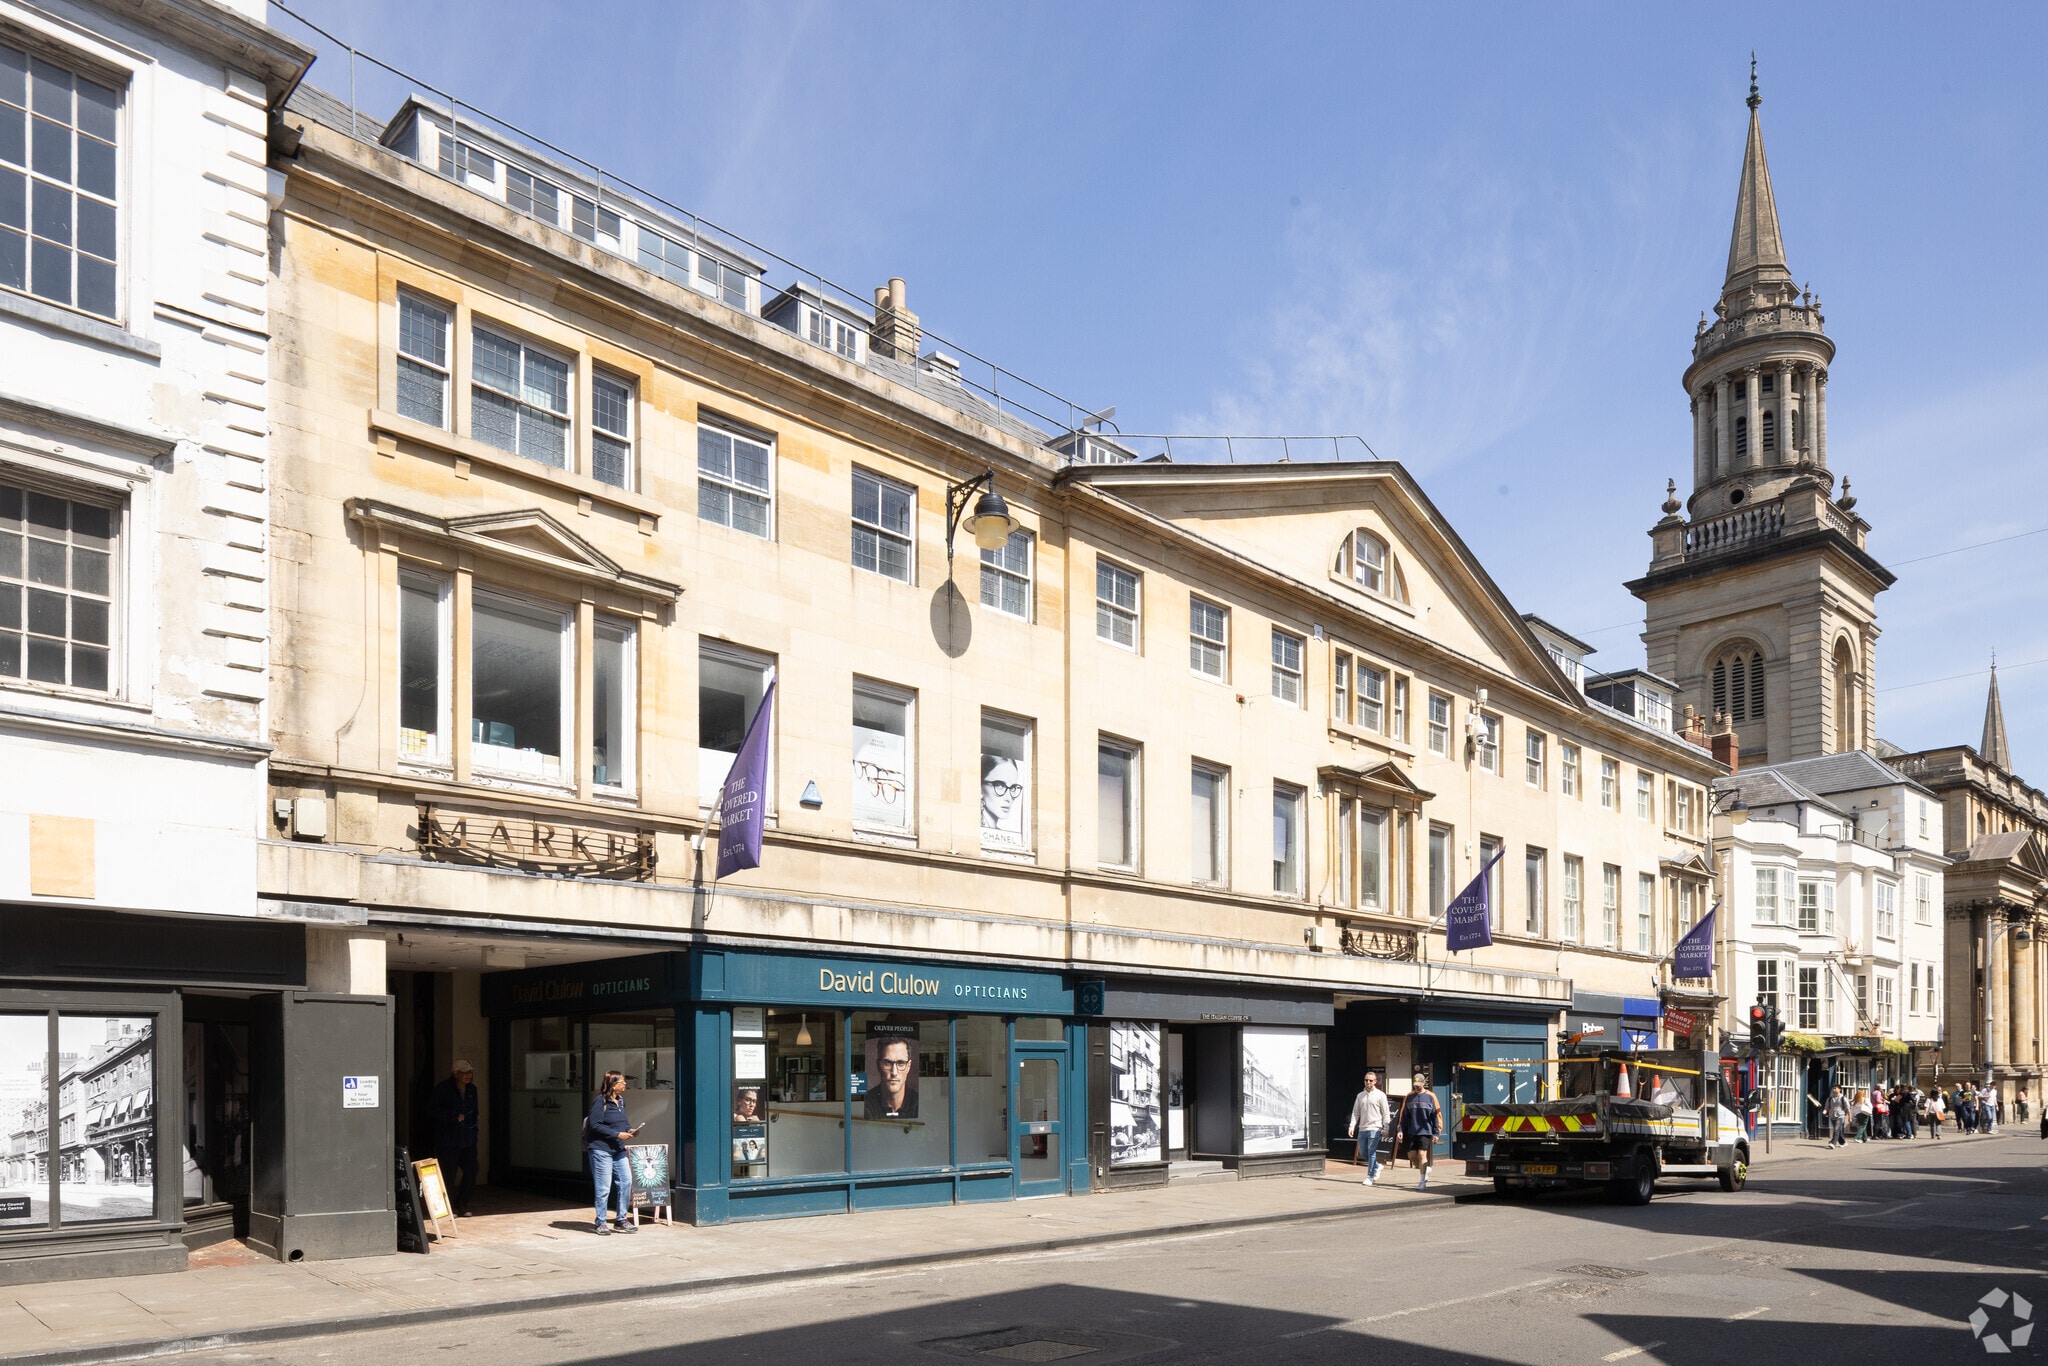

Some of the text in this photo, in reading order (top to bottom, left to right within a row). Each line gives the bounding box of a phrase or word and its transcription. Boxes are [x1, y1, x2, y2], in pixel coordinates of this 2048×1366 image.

[731, 777, 746, 793] THE
[721, 808, 753, 829] MARKET
[426, 811, 654, 870] MARKET
[983, 832, 1016, 844] CHANEL
[1451, 903, 1487, 914] COVEED
[1454, 913, 1485, 924] MARET
[513, 977, 650, 1003] David Clulow OPTICIANS
[819, 968, 1027, 999] David Clulow OPTICIANS
[1669, 1011, 1691, 1025] Money
